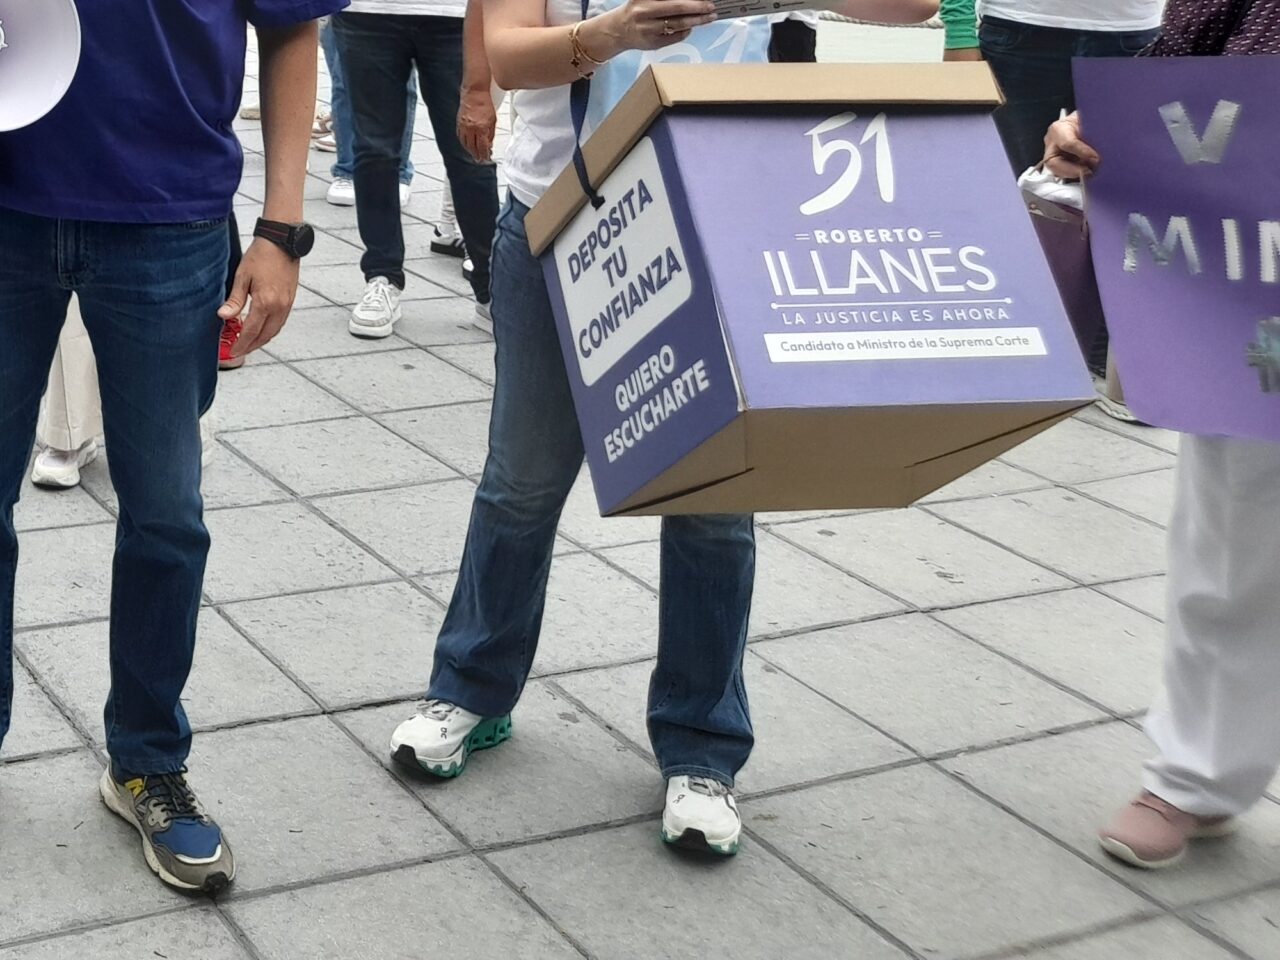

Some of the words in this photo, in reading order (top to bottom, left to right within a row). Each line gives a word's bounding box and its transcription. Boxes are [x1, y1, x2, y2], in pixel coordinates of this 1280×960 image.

[799, 112, 895, 216] 51
[1158, 99, 1241, 166] V
[567, 178, 654, 284] DEPOSITA
[813, 227, 924, 244] ROBERTO
[601, 245, 629, 288] TU
[763, 246, 998, 296] ILLANES
[578, 246, 683, 359] CONFIANZA
[782, 312, 806, 325] LA
[814, 310, 903, 325] JUSTICIA
[910, 309, 934, 322] ES
[942, 307, 1011, 321] AHORA
[780, 340, 845, 353] Candidato
[847, 342, 855, 351] a
[857, 339, 906, 350] Ministro
[909, 338, 923, 349] de
[925, 337, 937, 348] la
[938, 336, 993, 351] Suprema
[995, 335, 1030, 347] Corte
[603, 358, 711, 464] ESCUCHARTE
[615, 344, 675, 412] QUIERO
